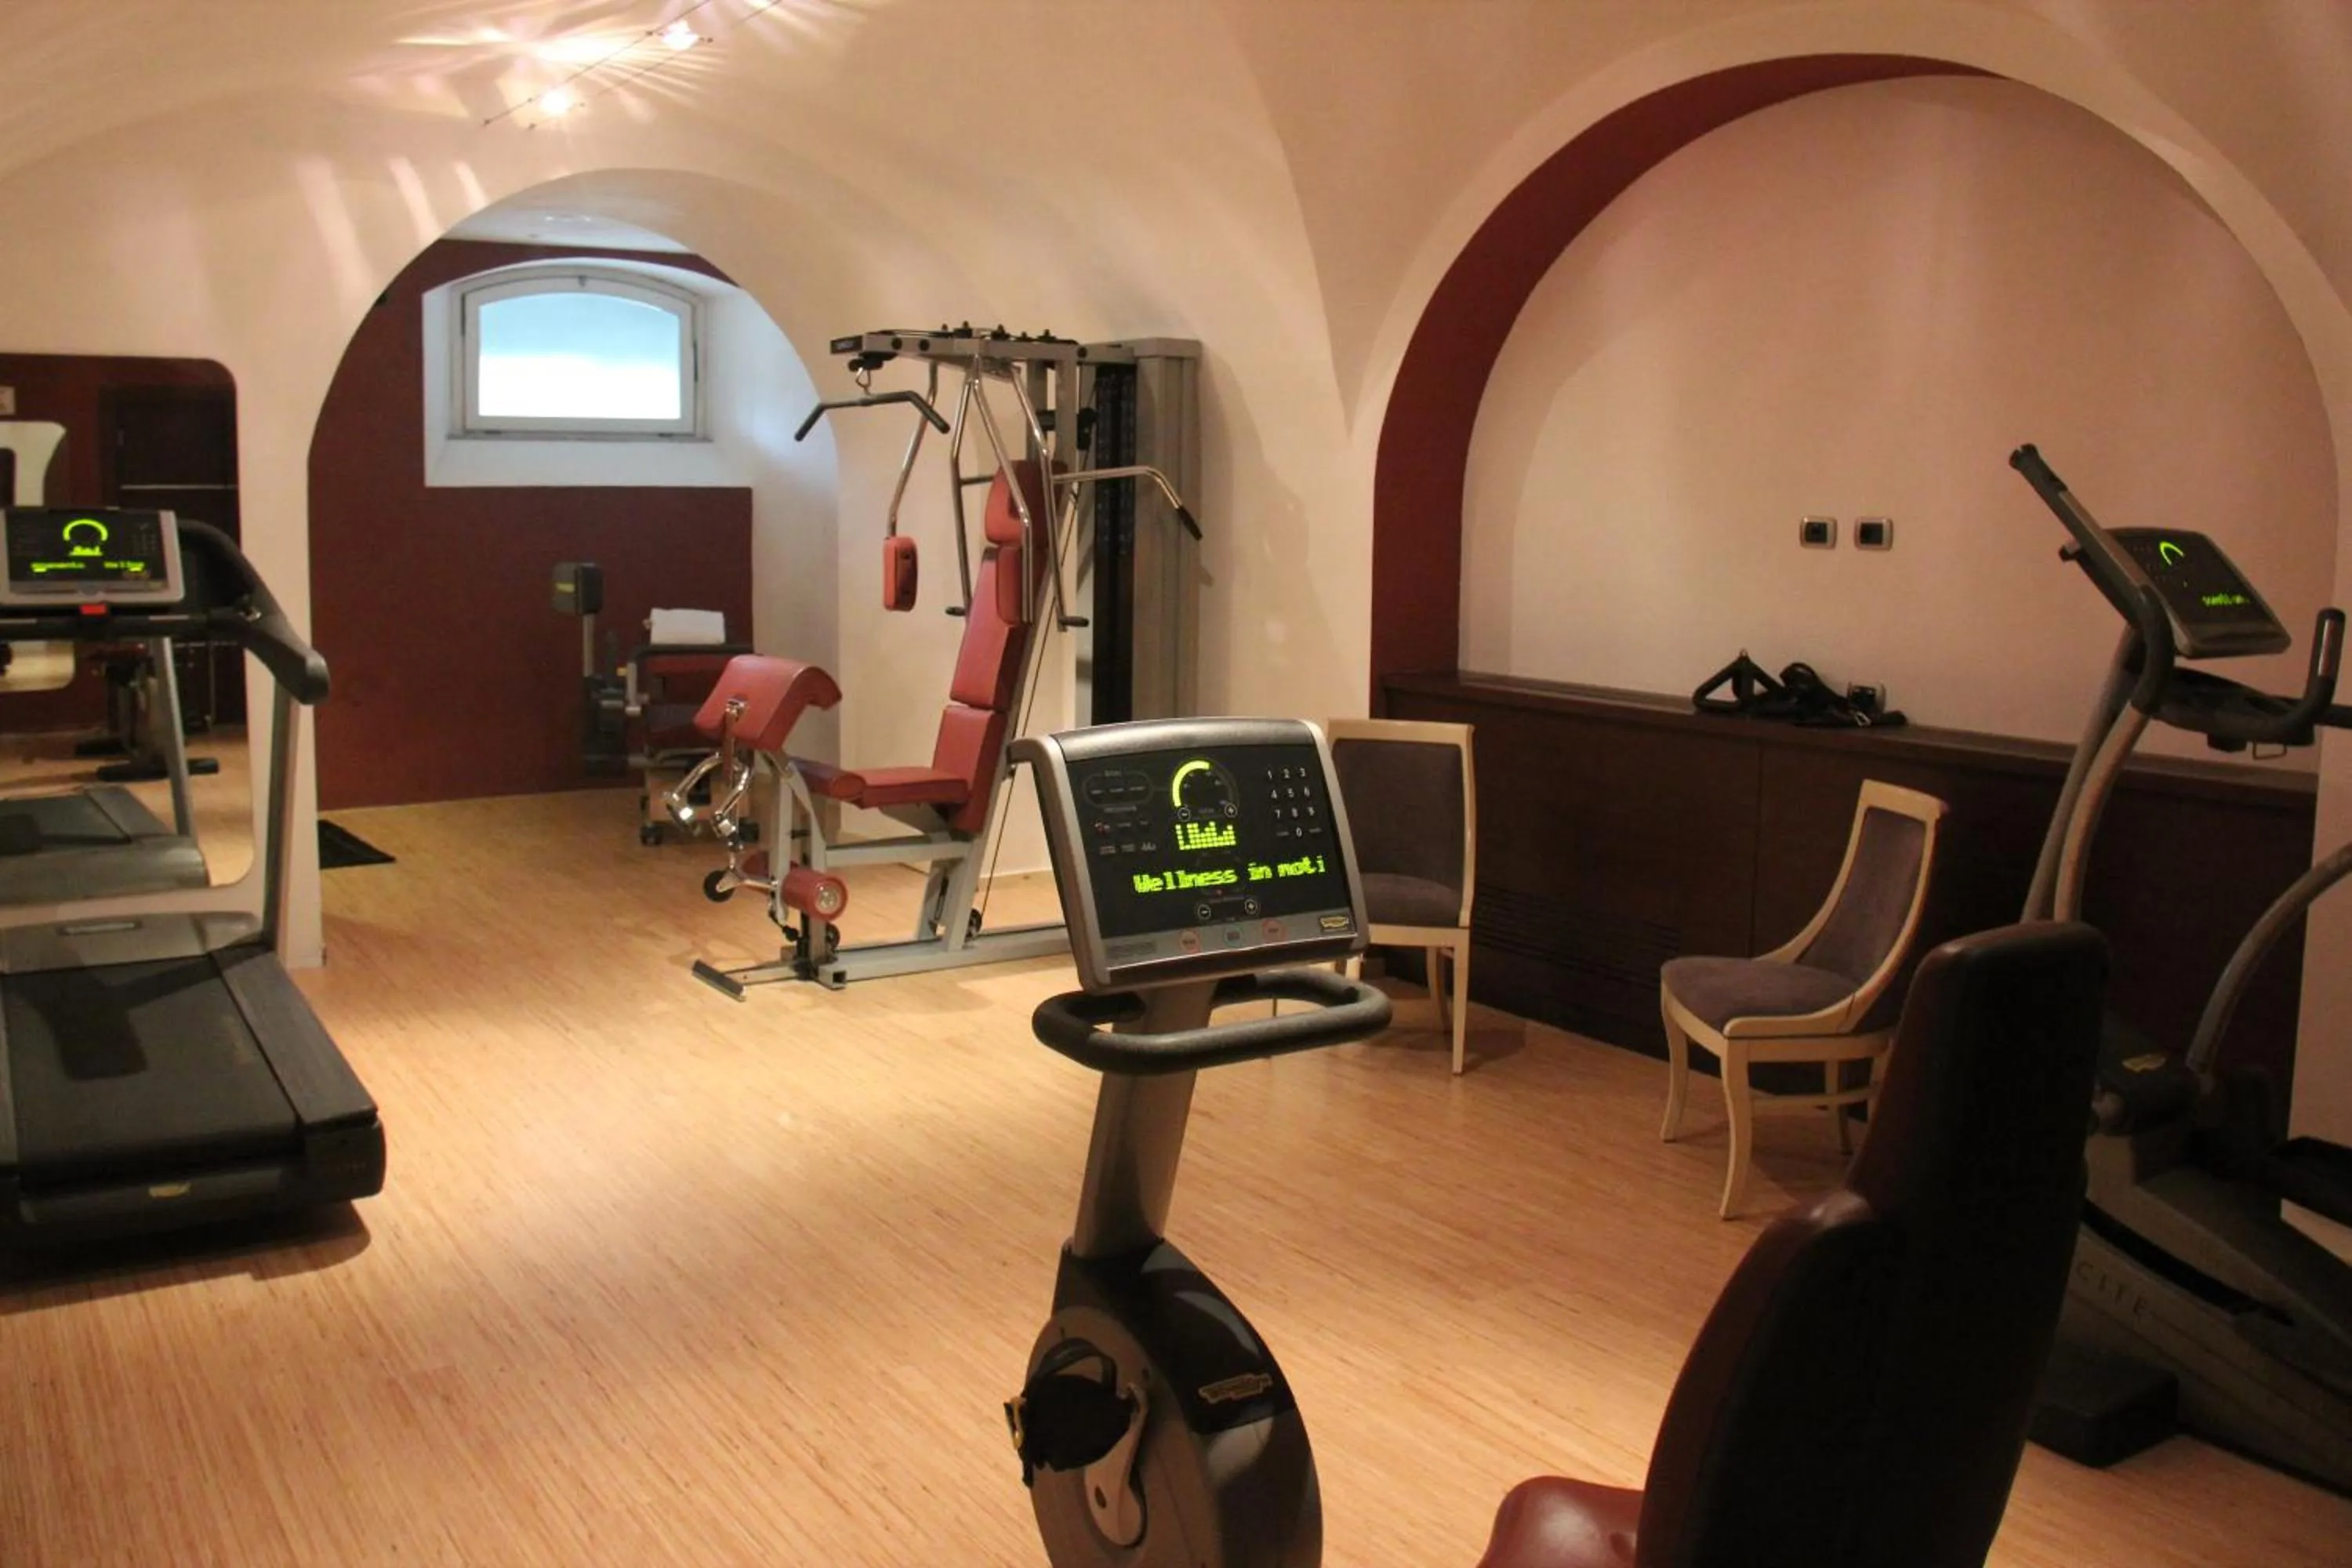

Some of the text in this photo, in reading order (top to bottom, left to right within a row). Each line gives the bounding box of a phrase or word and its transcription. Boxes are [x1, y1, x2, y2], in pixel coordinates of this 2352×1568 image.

[1295, 826, 1302, 837] 0
[1133, 869, 1237, 893] Wellness
[1247, 862, 1272, 880] in
